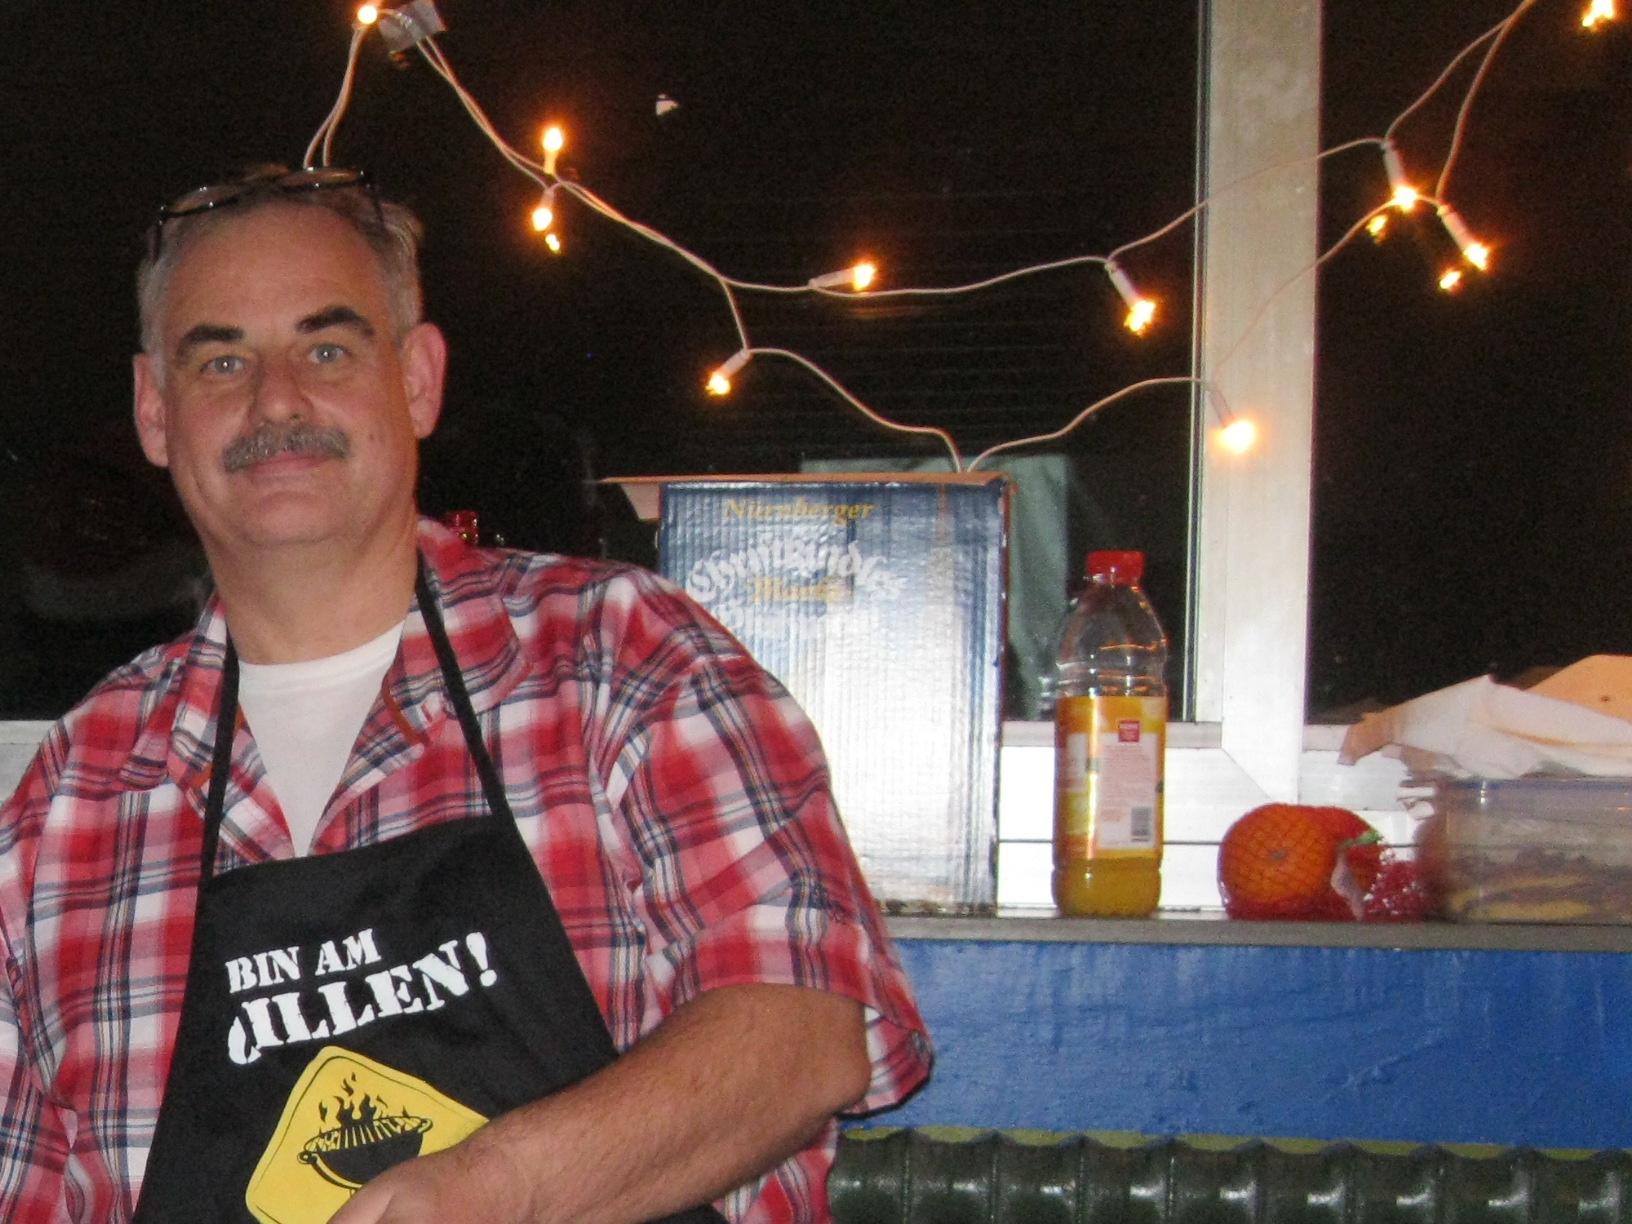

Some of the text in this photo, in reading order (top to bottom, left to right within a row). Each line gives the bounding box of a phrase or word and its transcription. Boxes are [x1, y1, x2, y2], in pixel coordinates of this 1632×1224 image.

[724, 498, 876, 527] Nürnberger
[225, 928, 382, 993] BIN AM
[227, 931, 498, 1065] ILLEN!
